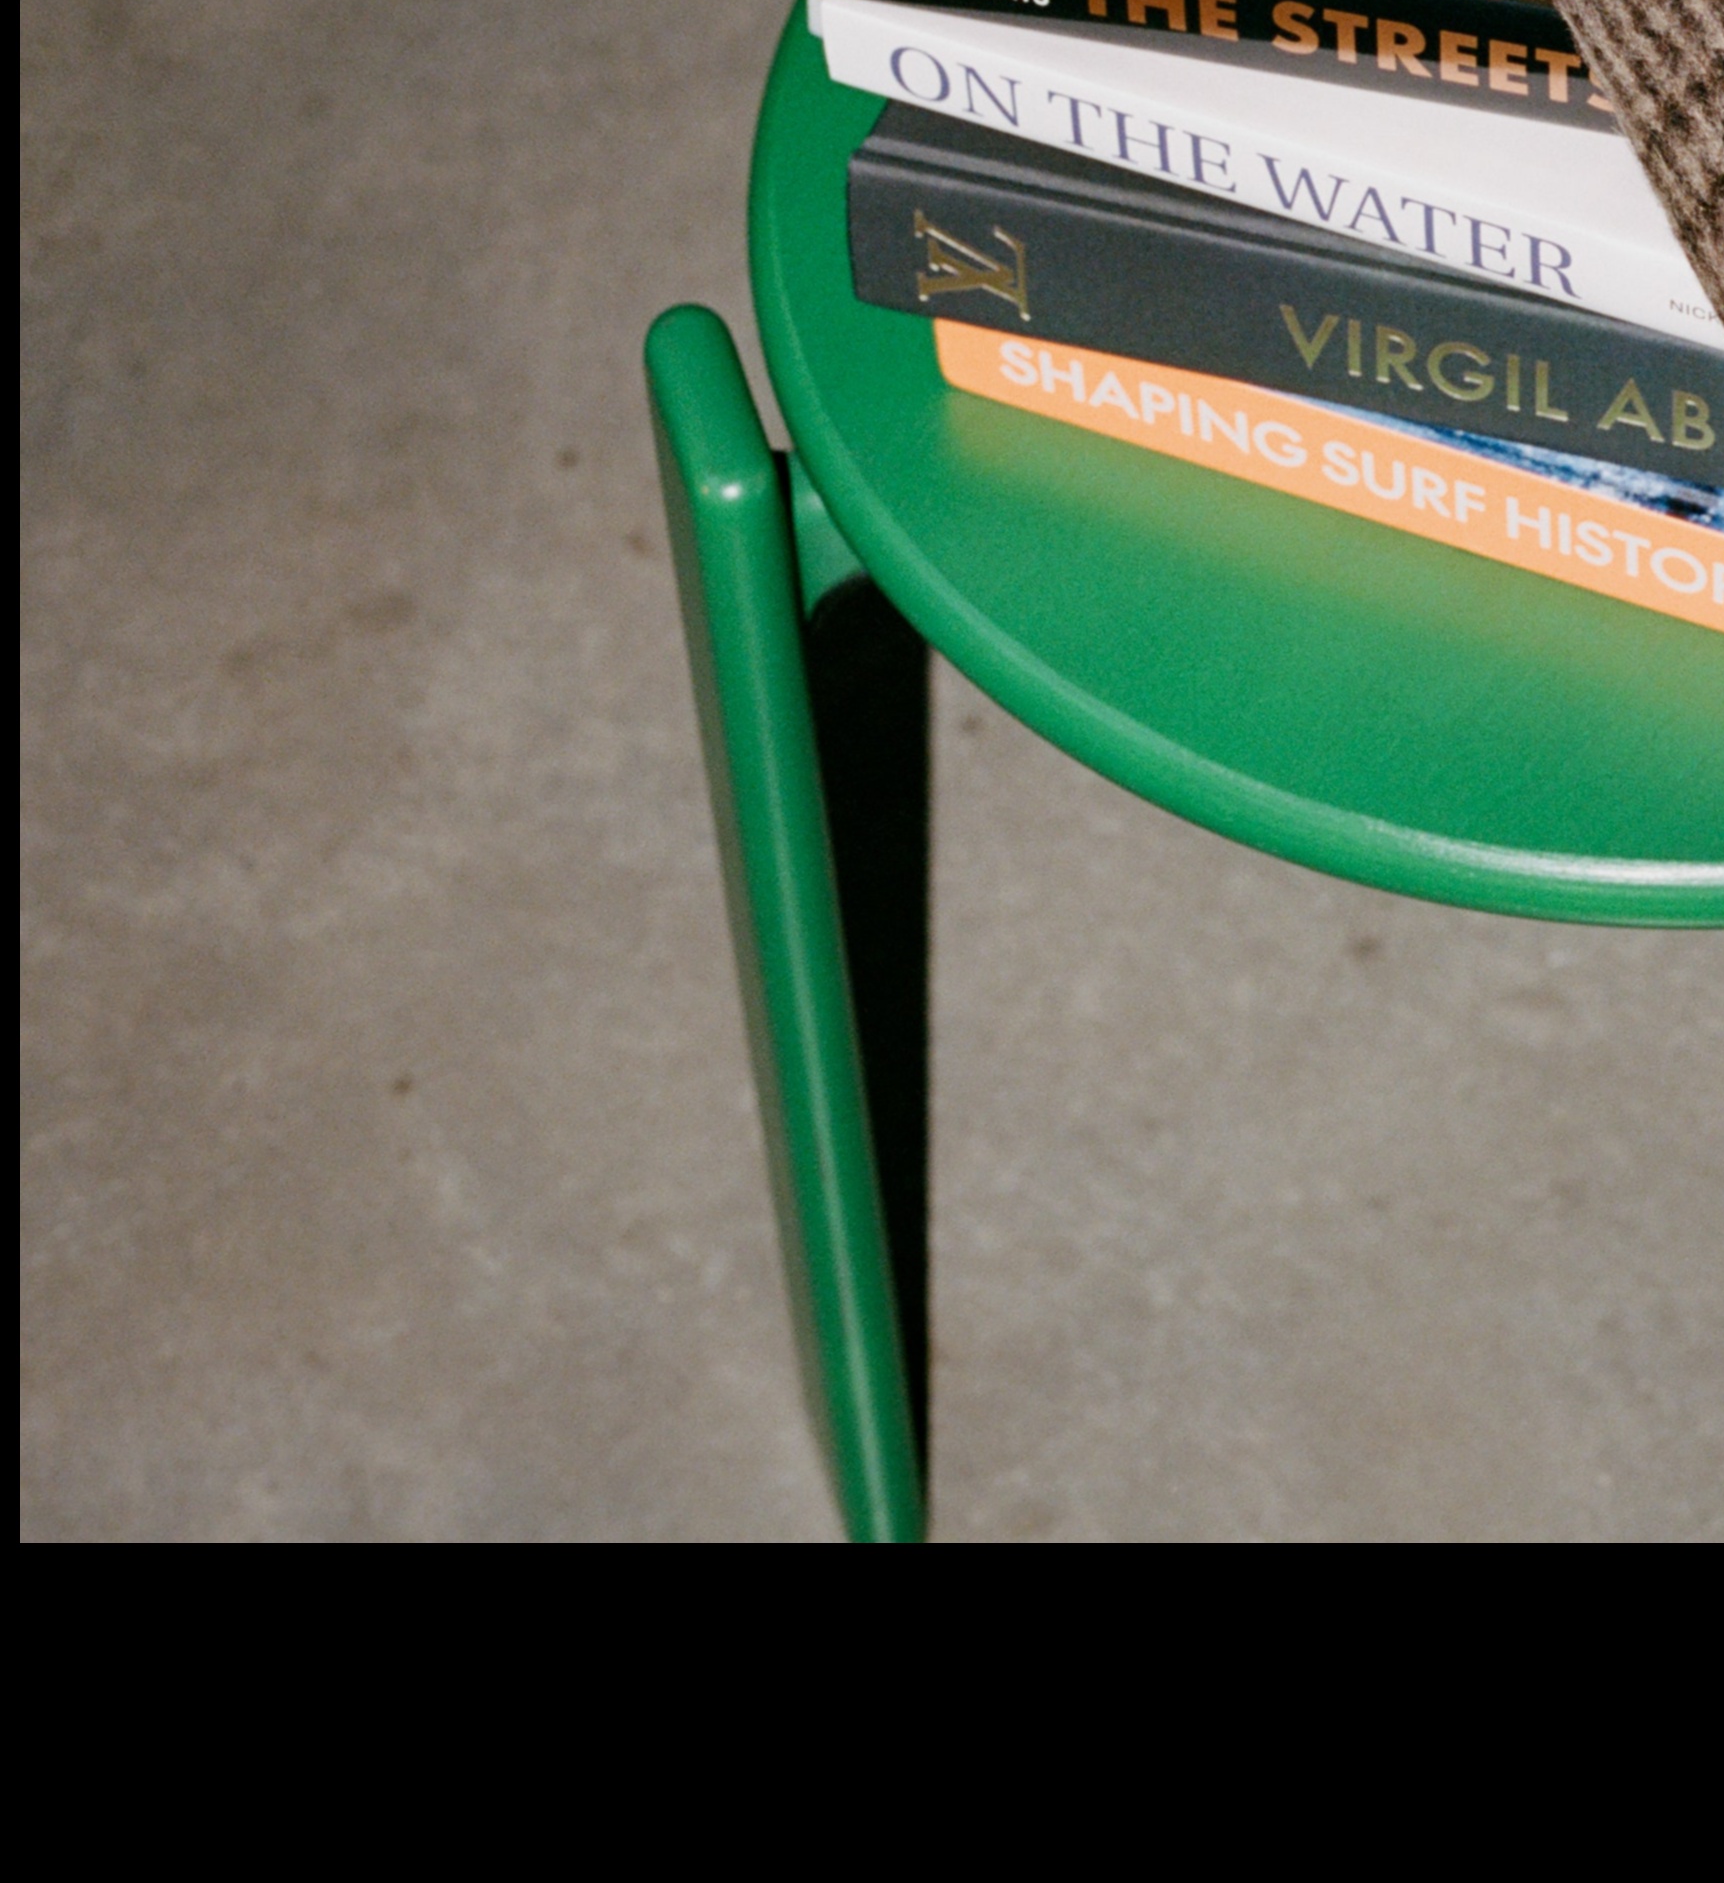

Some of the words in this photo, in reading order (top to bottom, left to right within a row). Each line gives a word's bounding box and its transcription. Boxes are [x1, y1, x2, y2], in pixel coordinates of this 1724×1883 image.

[889, 46, 1023, 127] ON
[1047, 90, 1237, 194] THE
[1258, 153, 1583, 298] WATER
[998, 338, 1308, 470] SHAPING
[1321, 441, 1488, 525] SURF
[1278, 303, 1570, 423] VIRGIL
